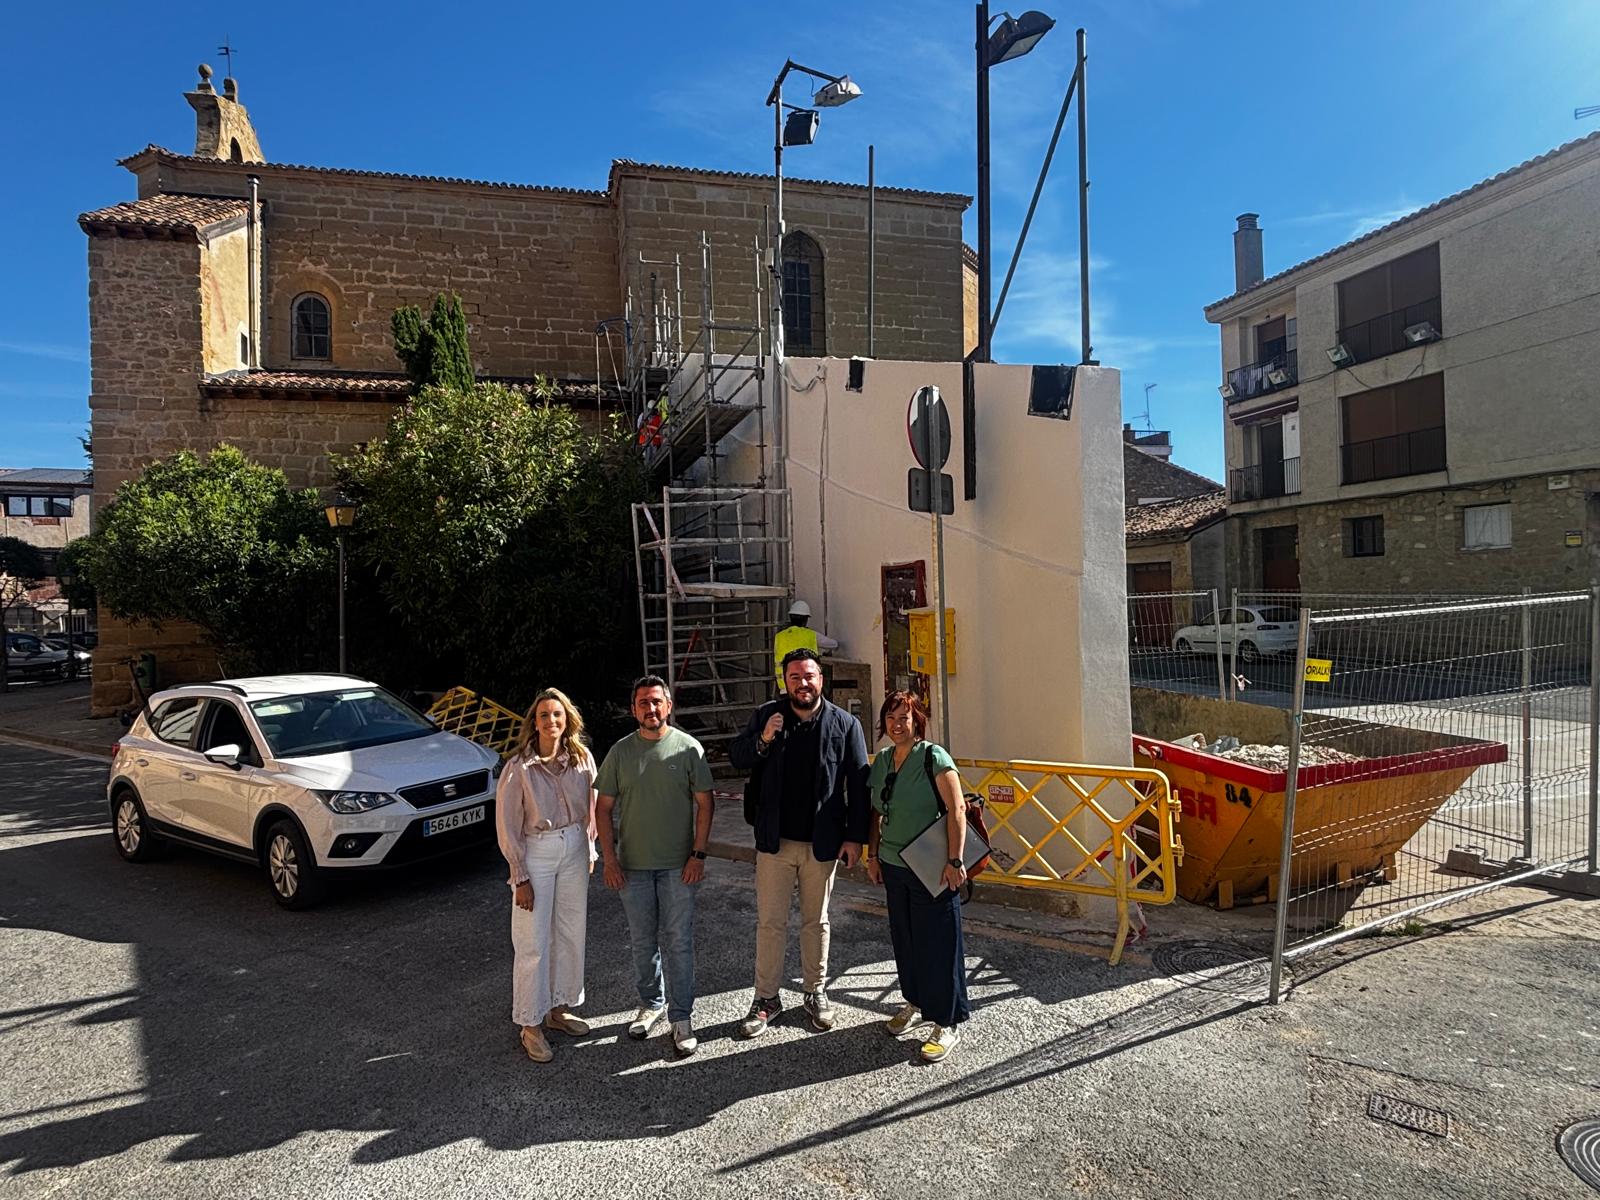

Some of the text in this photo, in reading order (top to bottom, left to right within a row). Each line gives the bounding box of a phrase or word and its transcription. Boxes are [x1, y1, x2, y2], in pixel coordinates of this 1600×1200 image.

[1225, 783, 1252, 809] 84
[430, 808, 482, 833] 5646 KYK
